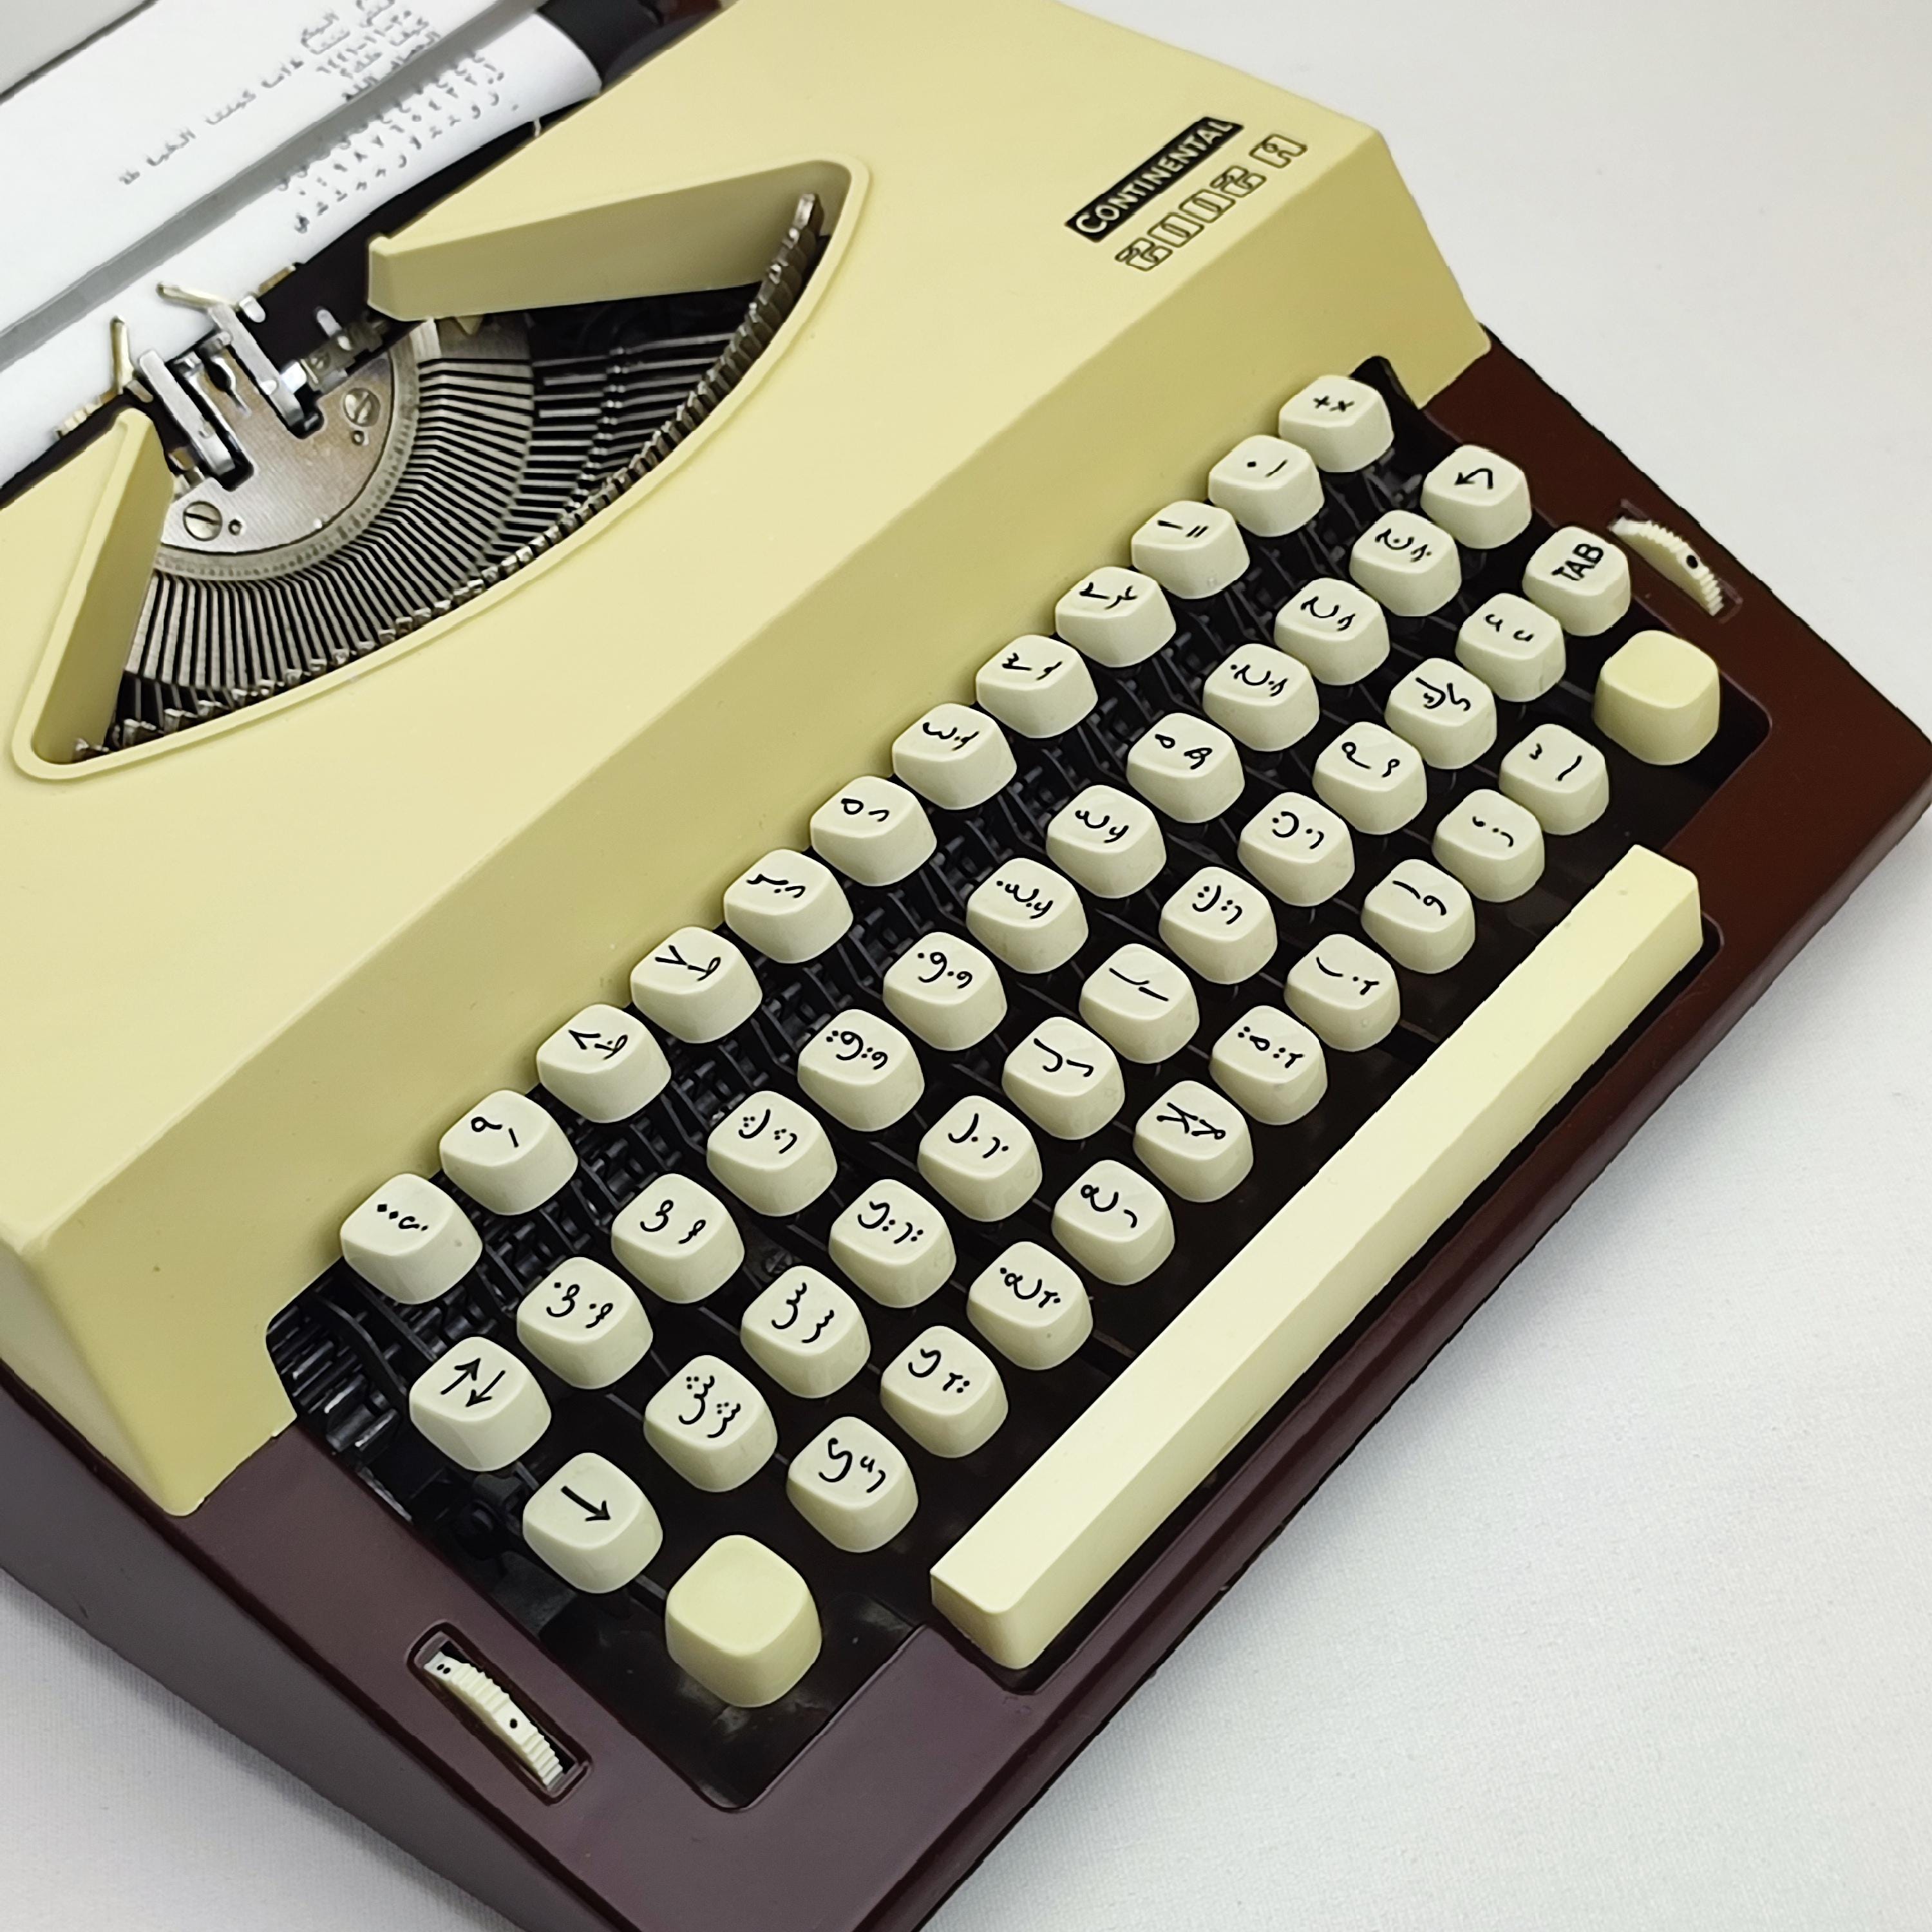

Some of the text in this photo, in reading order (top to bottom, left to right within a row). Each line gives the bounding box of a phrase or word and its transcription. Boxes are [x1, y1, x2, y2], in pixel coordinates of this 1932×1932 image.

[1075, 120, 1233, 234] CONTINENTAL
[1113, 165, 1267, 272] 2002
[1374, 527, 1416, 551] ج
[1550, 542, 1605, 582] TAB
[1300, 595, 1340, 620] ح
[1001, 652, 1033, 672] ٣
[1229, 663, 1272, 687] خ
[1340, 741, 1372, 770] م
[1074, 809, 1111, 830] ع
[1271, 810, 1300, 839] ن
[995, 880, 1041, 904] غ
[1191, 884, 1222, 913] ت
[654, 945, 688, 968] ٧
[687, 956, 721, 982] ط
[916, 951, 948, 984] ف
[567, 1028, 602, 1051] ٨
[825, 1029, 865, 1062] ق
[1032, 1037, 1064, 1074] ل
[469, 1115, 504, 1133] ٩
[737, 1108, 772, 1140] ث
[947, 1112, 980, 1144] ب
[1079, 1184, 1120, 1213] ع
[639, 1198, 675, 1233] ص
[856, 1200, 896, 1233] ي
[545, 1281, 581, 1319] ض
[770, 1281, 808, 1331] س
[677, 1374, 716, 1426] ش
